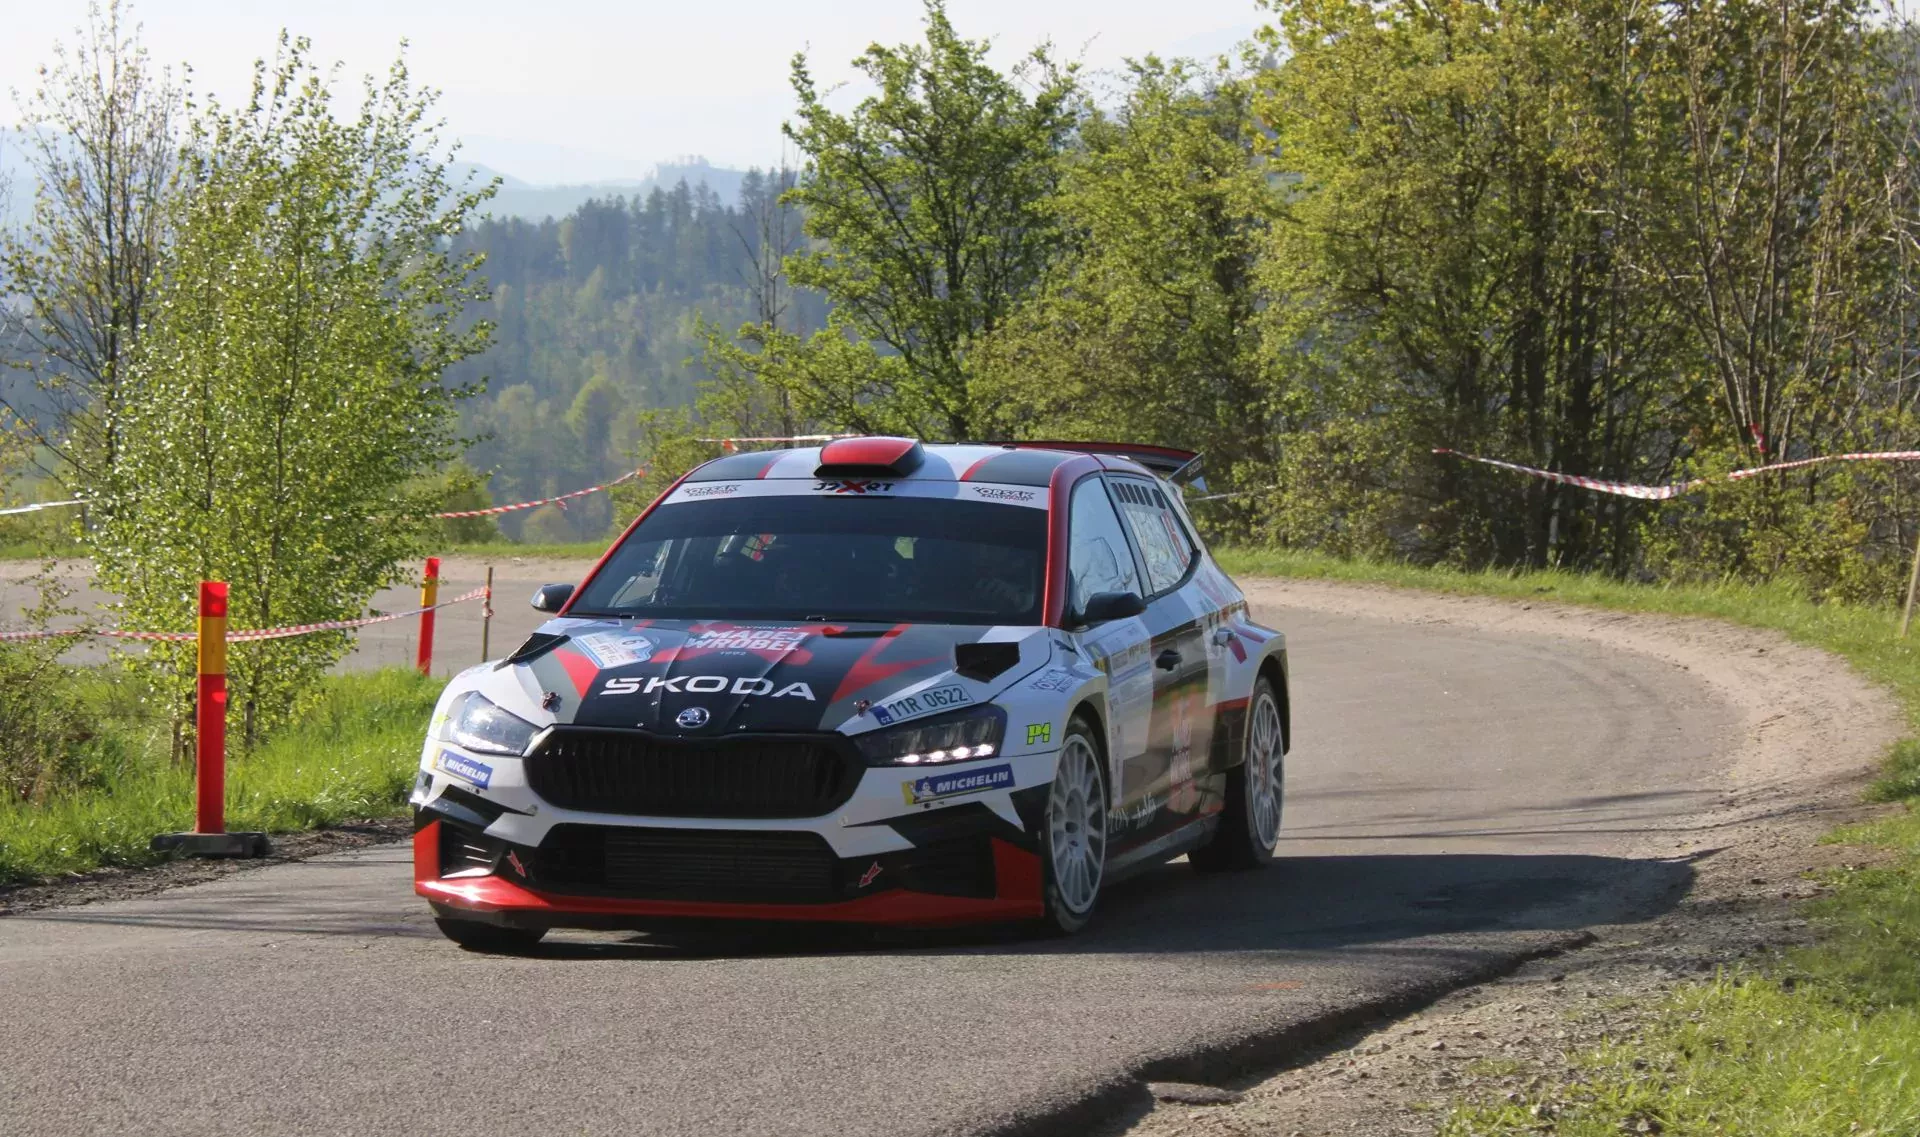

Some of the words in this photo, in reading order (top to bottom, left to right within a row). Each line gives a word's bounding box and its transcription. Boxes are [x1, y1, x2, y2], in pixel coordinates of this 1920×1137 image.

[700, 630, 809, 641] MADEJ
[600, 676, 816, 700] SKODA
[888, 700, 923, 718] 11R
[924, 688, 969, 708] 0622
[445, 759, 489, 782] MICHELIN
[936, 770, 1009, 793] MICHELIN
